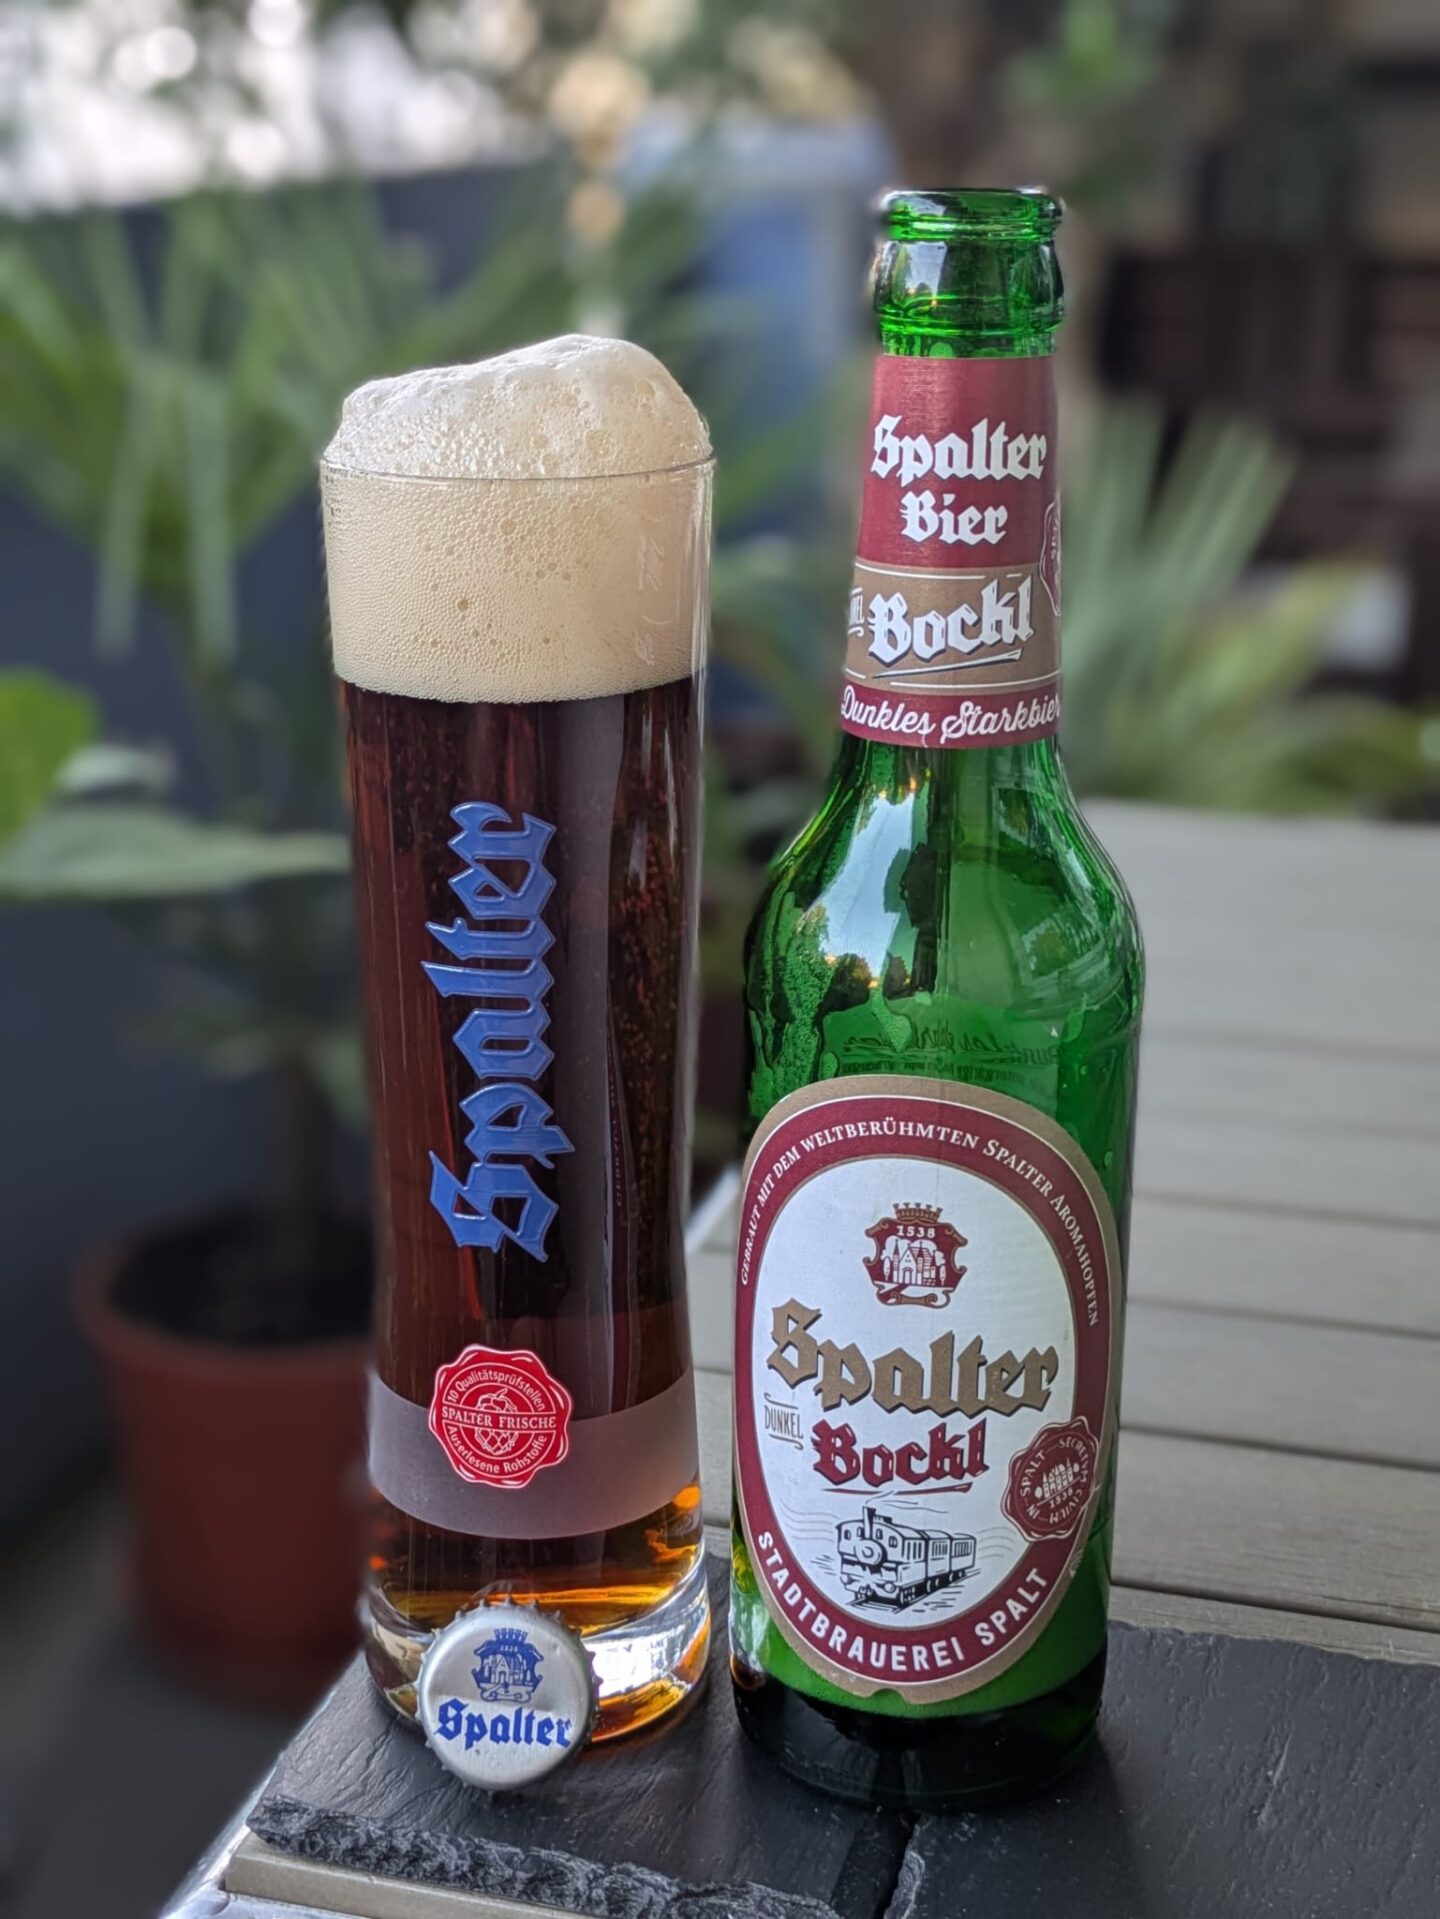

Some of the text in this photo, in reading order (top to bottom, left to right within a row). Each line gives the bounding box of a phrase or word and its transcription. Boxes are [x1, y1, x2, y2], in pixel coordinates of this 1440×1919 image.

[870, 414, 1047, 487] Spalter
[900, 489, 1008, 545] Bier
[868, 575, 1033, 668] Bockl
[841, 684, 936, 748] Dunkles
[421, 801, 575, 1262] Spalter
[741, 1204, 761, 1285] GEBRAUT
[757, 1176, 776, 1208] MIT
[773, 1146, 801, 1180] DEM
[800, 1117, 980, 1152] WELTBERÜHMTEN
[897, 1225, 936, 1239] 1538
[766, 1298, 1059, 1419] Spalter
[441, 1406, 557, 1430] SPALTER FRISCHE
[455, 1369, 546, 1412] Qualitätsprüfstellen
[448, 1425, 547, 1474] Auserlesene Rohstoffe
[764, 1404, 804, 1440] DUNKEL
[811, 1418, 989, 1486] Bockl
[1020, 1451, 1045, 1498] SPALT
[757, 1531, 1048, 1672] STADTBRAUEREI SPALT
[433, 1698, 573, 1750] Spalter
